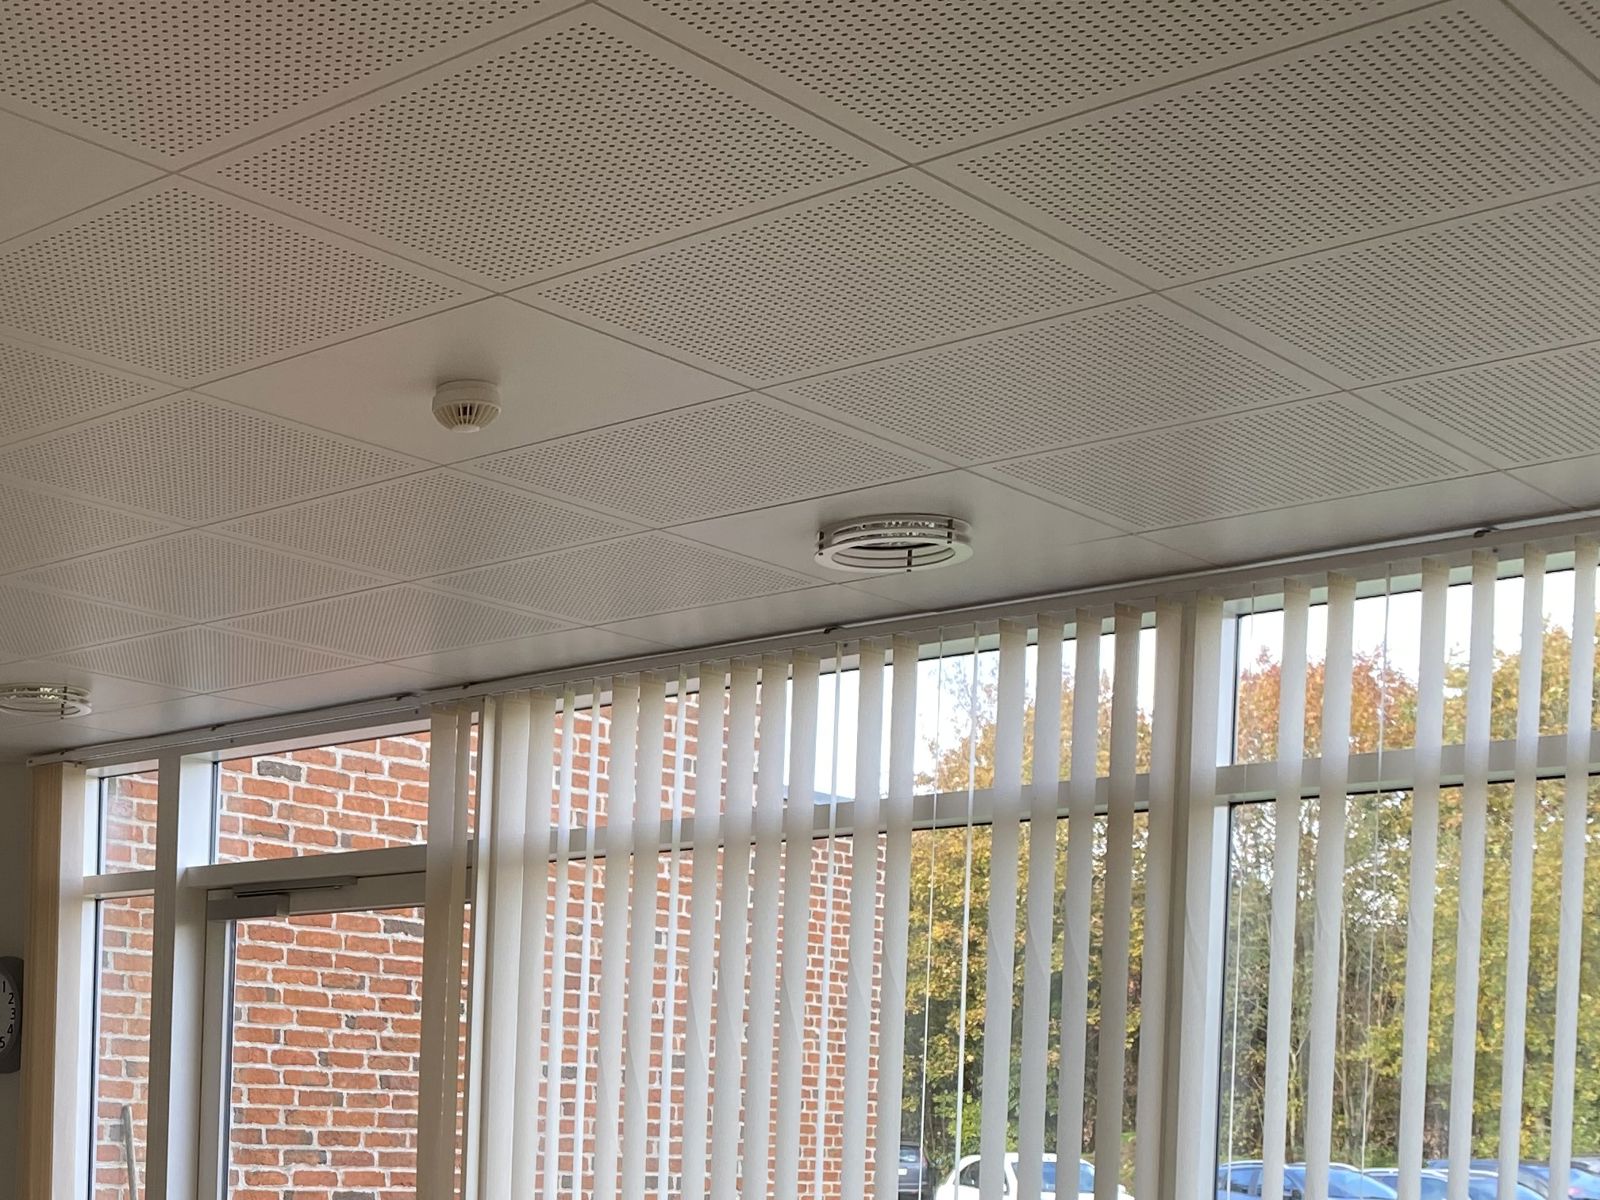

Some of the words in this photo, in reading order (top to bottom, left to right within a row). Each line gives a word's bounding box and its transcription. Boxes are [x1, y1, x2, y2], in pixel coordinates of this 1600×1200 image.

[2, 981, 6, 993] 1
[9, 993, 14, 1004] 2
[11, 1008, 16, 1019] 3
[7, 1024, 13, 1034] 4
[0, 1036, 5, 1048] 5
